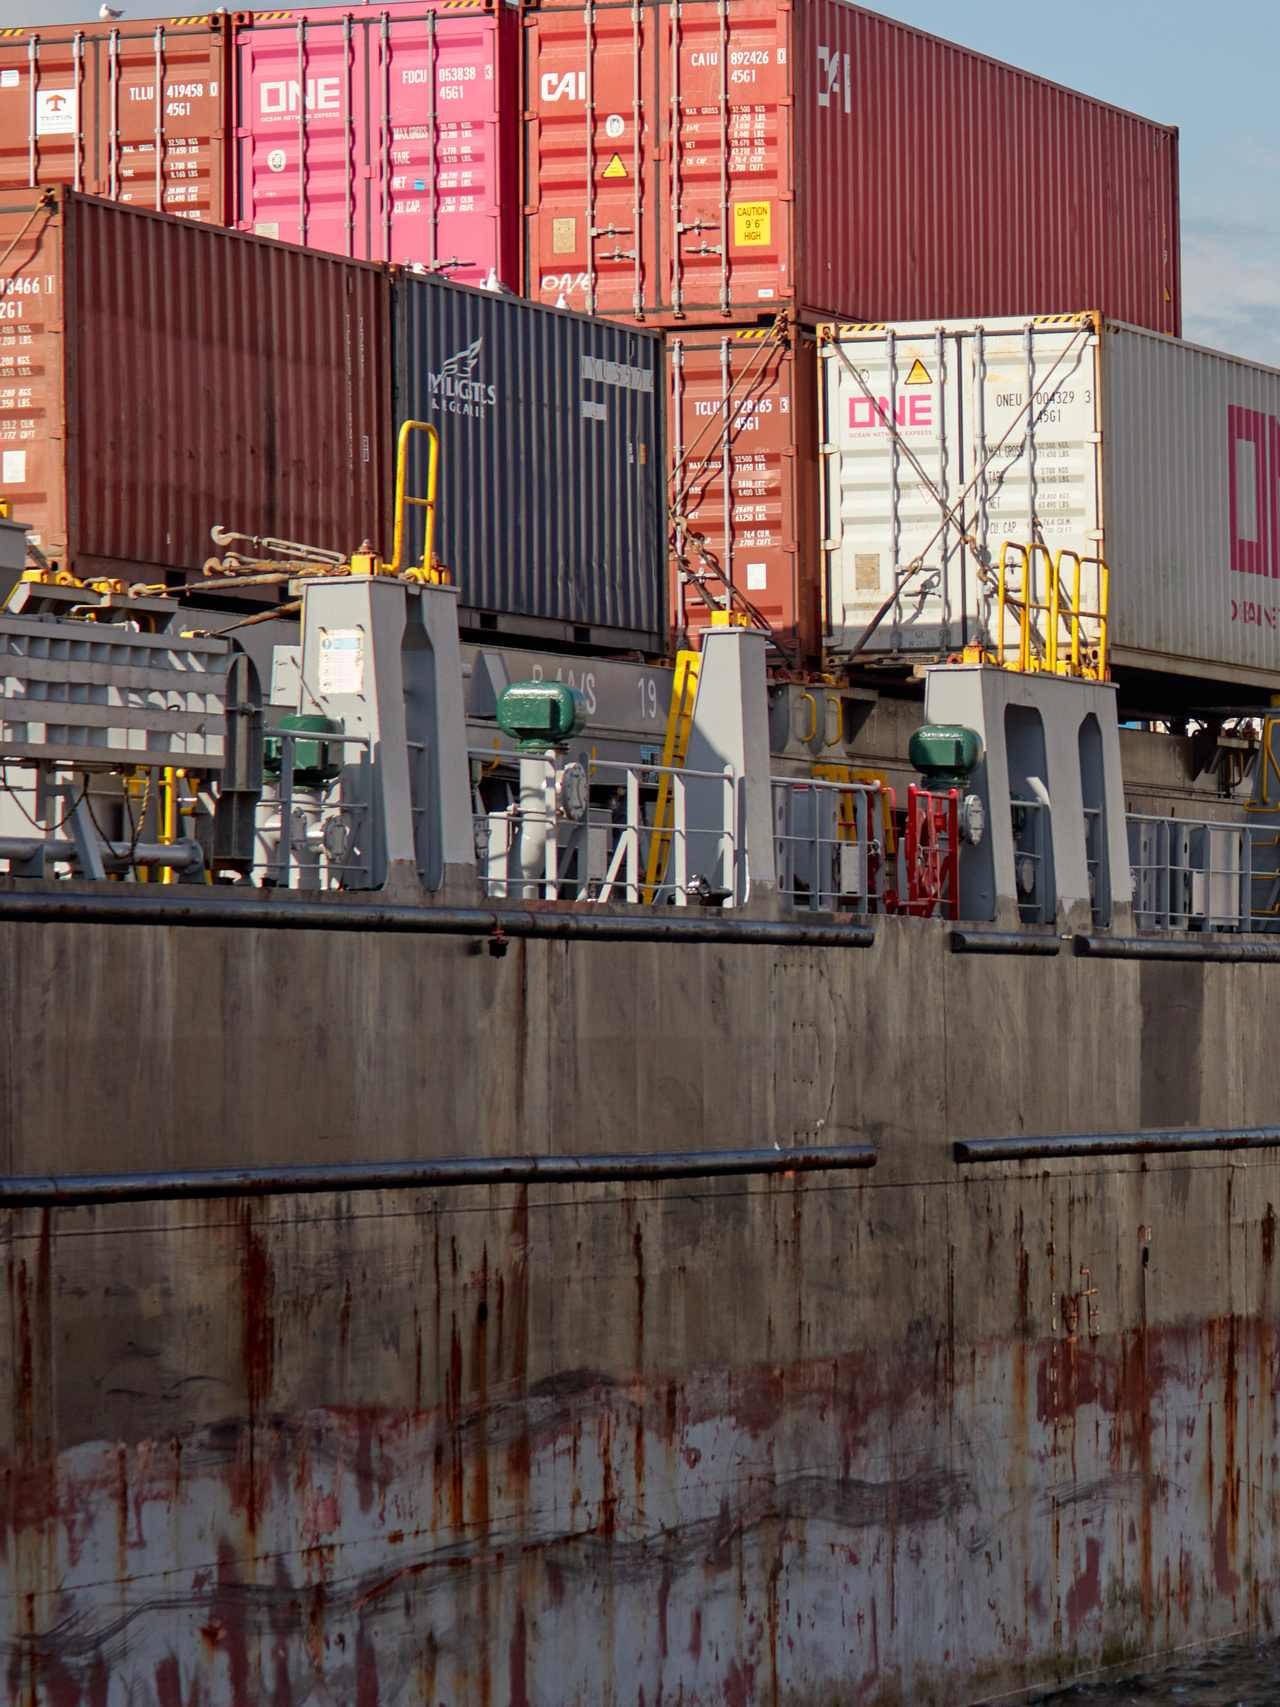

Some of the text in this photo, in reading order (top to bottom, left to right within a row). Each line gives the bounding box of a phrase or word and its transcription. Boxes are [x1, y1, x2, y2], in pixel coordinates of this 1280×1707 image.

[691, 52, 718, 66] CAIU
[730, 51, 769, 65] 892426
[402, 65, 493, 84] FDCU 053838 3
[731, 69, 756, 83] 45G1
[130, 86, 154, 101] TLLU
[166, 83, 204, 98] 419458
[439, 85, 464, 100] 45G1
[541, 71, 586, 102] CAI
[260, 77, 340, 114] ONE
[166, 102, 190, 116] 45G1
[392, 151, 411, 165] TARE
[393, 176, 407, 189] NET
[737, 206, 768, 217] CAUTION
[744, 231, 762, 241] HIGH
[996, 390, 1092, 407] ONEU 004329 3
[734, 399, 773, 415] 928165
[780, 398, 789, 413] 3
[848, 394, 932, 429] ONE
[734, 416, 760, 431] 45G1
[1037, 409, 1062, 423] 45G1
[637, 677, 657, 719] 19
